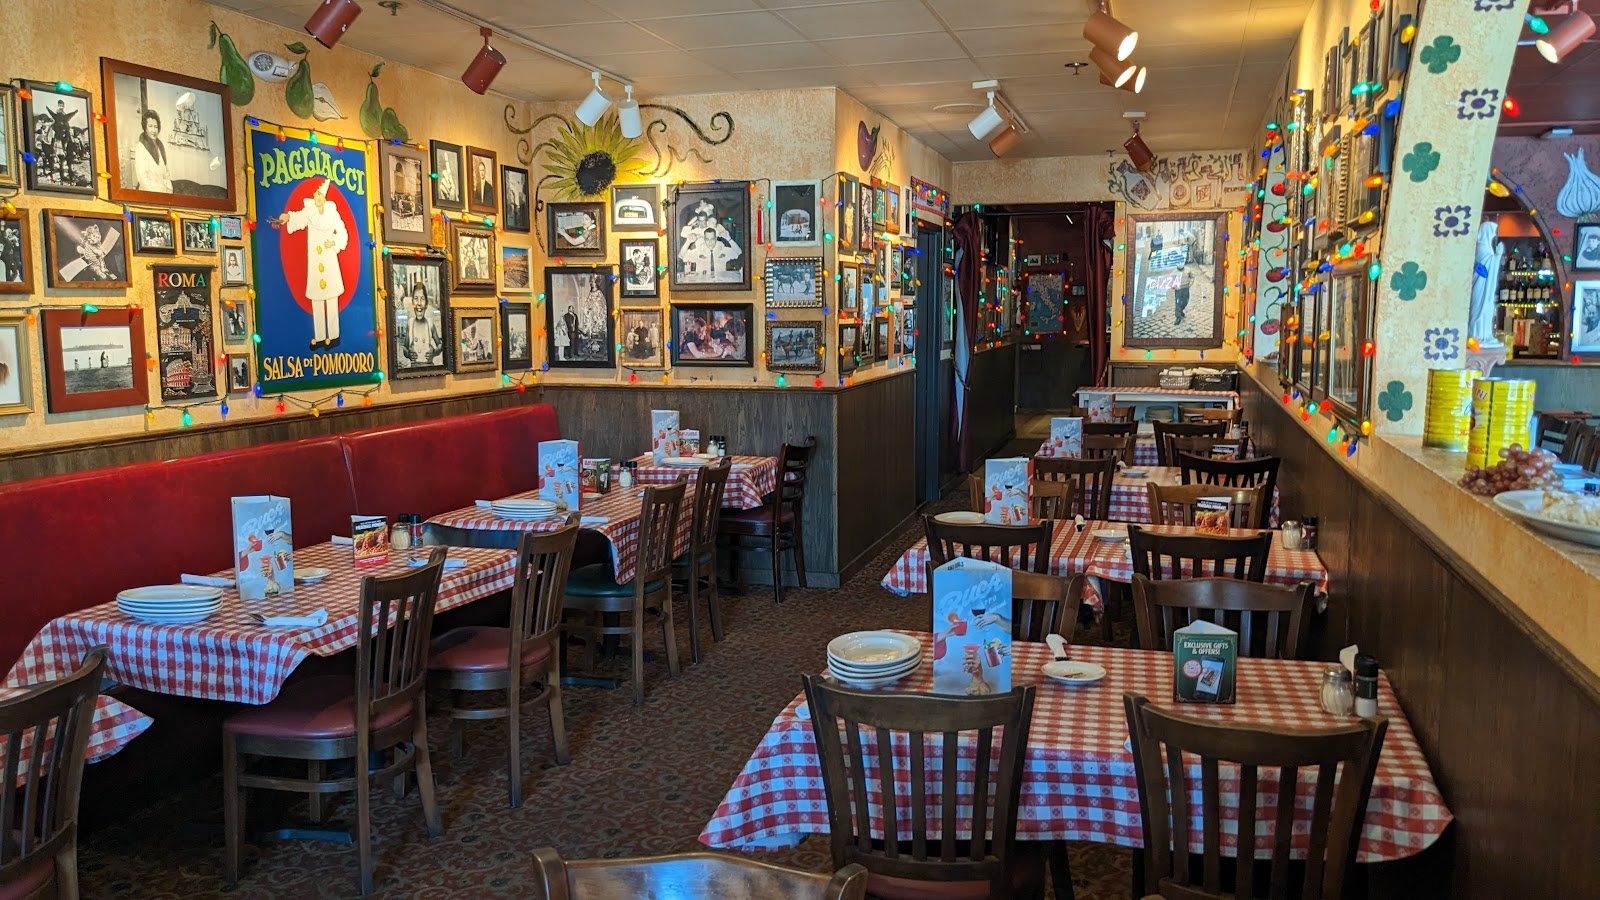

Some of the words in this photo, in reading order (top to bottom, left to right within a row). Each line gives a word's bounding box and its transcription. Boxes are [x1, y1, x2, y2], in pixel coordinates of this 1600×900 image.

[259, 146, 365, 195] PAGLIACCI
[158, 272, 206, 288] ROMA
[263, 356, 304, 381] SALSA
[303, 358, 313, 368] DI
[313, 352, 375, 377] POMODORO
[940, 572, 1003, 614] BUCA
[1213, 642, 1228, 650] GIFTS
